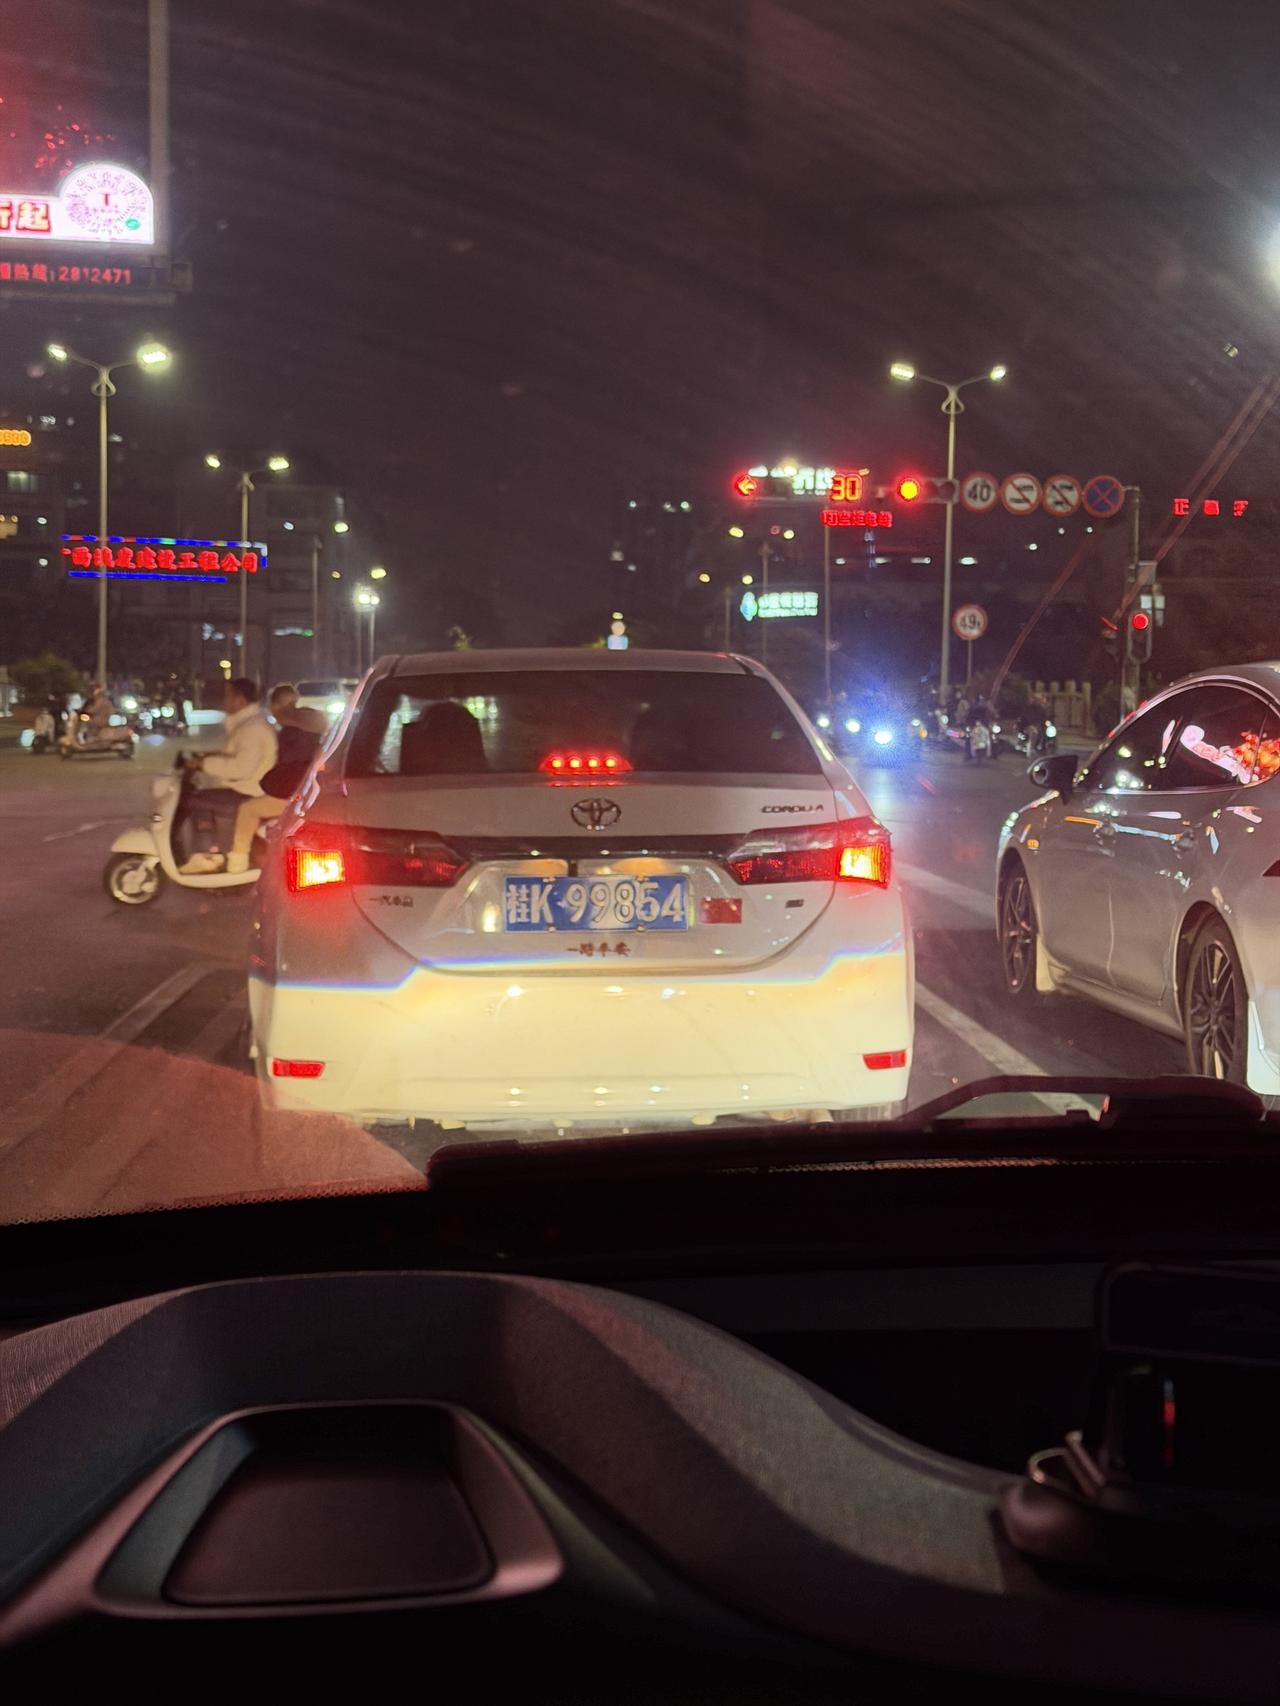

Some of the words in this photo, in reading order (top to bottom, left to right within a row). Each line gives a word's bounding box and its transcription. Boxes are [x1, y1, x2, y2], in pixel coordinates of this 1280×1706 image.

[831, 472, 863, 502] 30
[967, 482, 992, 502] 40
[566, 942, 632, 957] 一路平安
